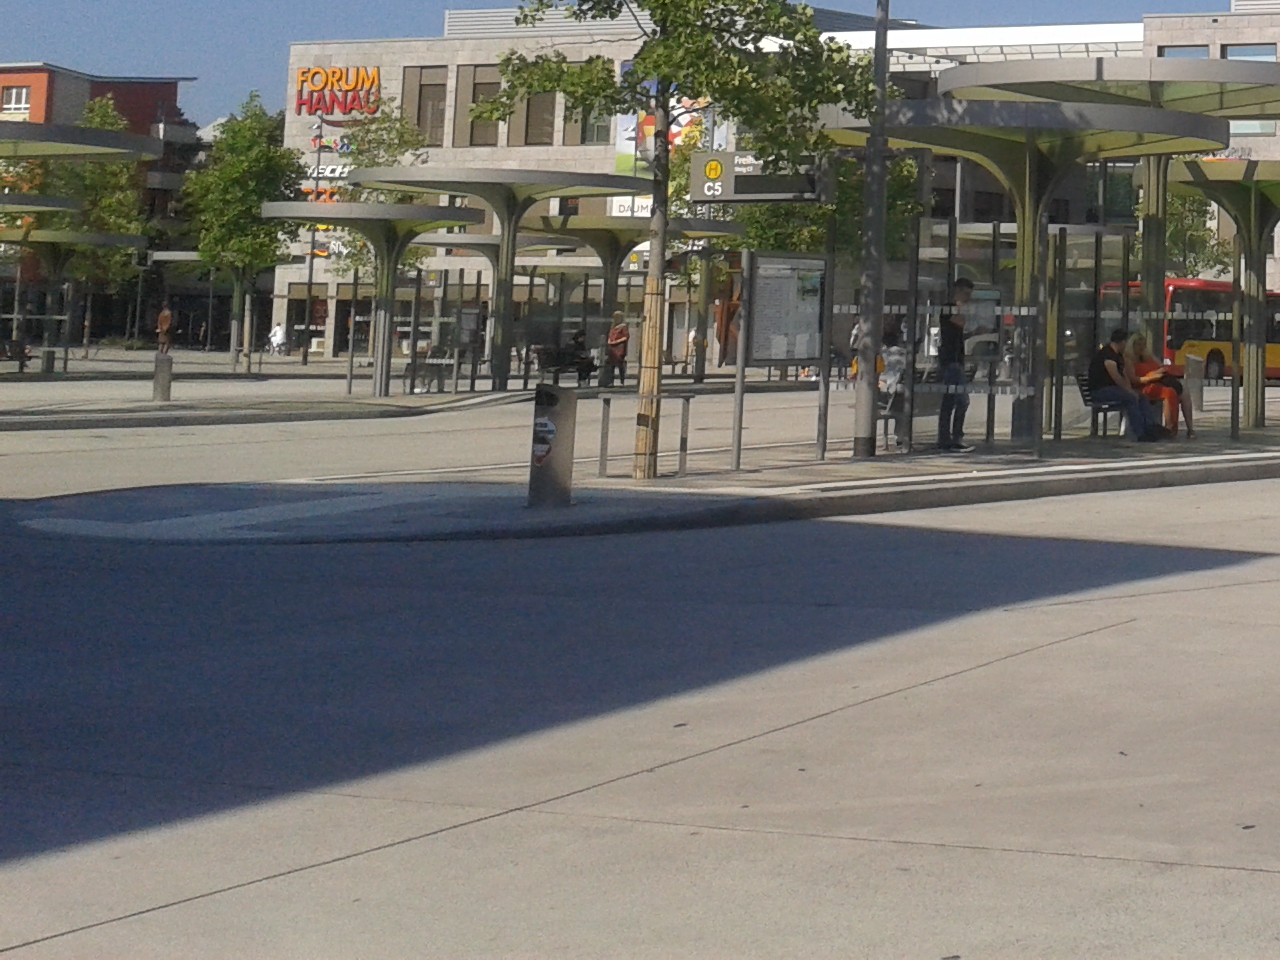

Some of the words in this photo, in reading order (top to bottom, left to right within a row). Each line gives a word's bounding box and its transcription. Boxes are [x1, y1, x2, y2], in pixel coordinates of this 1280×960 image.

[297, 66, 380, 91] FORUM
[295, 90, 380, 115] HANAU
[704, 181, 722, 196] C5
